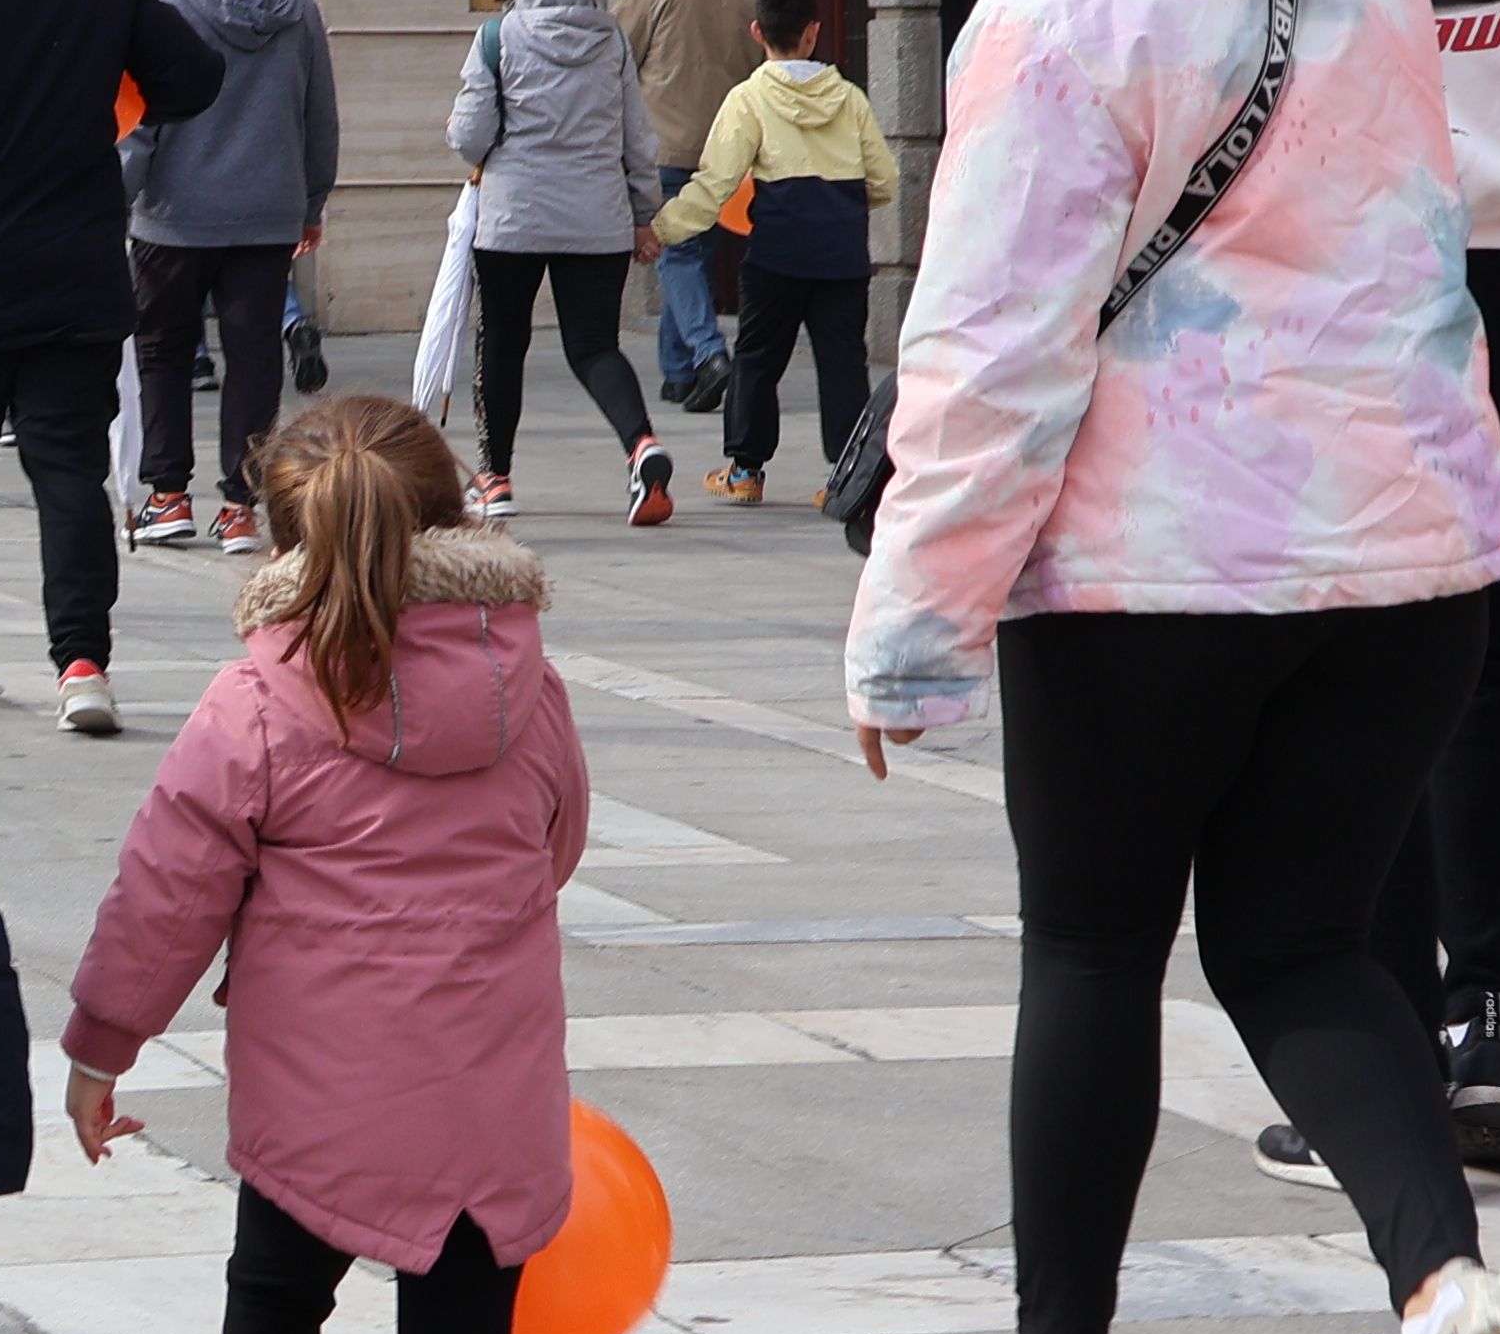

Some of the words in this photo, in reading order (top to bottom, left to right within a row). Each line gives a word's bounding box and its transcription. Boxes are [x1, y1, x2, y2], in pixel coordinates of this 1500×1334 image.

[1262, 76, 1284, 105] Y
[1184, 107, 1266, 197] LOLA
[1485, 998, 1497, 1038] adidas
